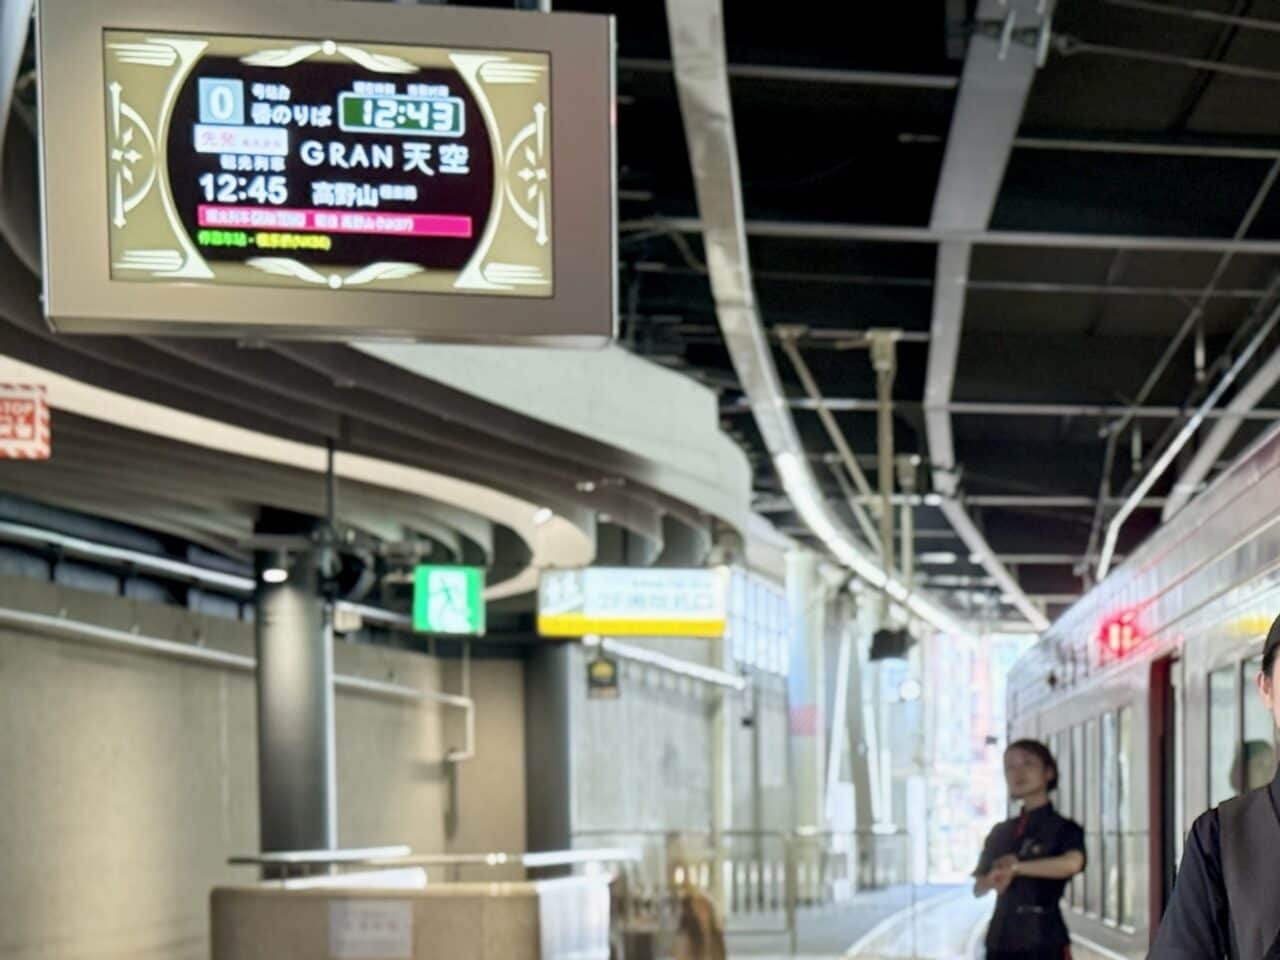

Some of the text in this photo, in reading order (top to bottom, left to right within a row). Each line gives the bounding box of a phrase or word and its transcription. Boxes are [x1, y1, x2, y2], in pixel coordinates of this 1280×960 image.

[210, 85, 234, 120] 0
[362, 99, 453, 131] 12:43
[300, 140, 470, 176] GRAN 天空
[199, 173, 288, 205] 12:45
